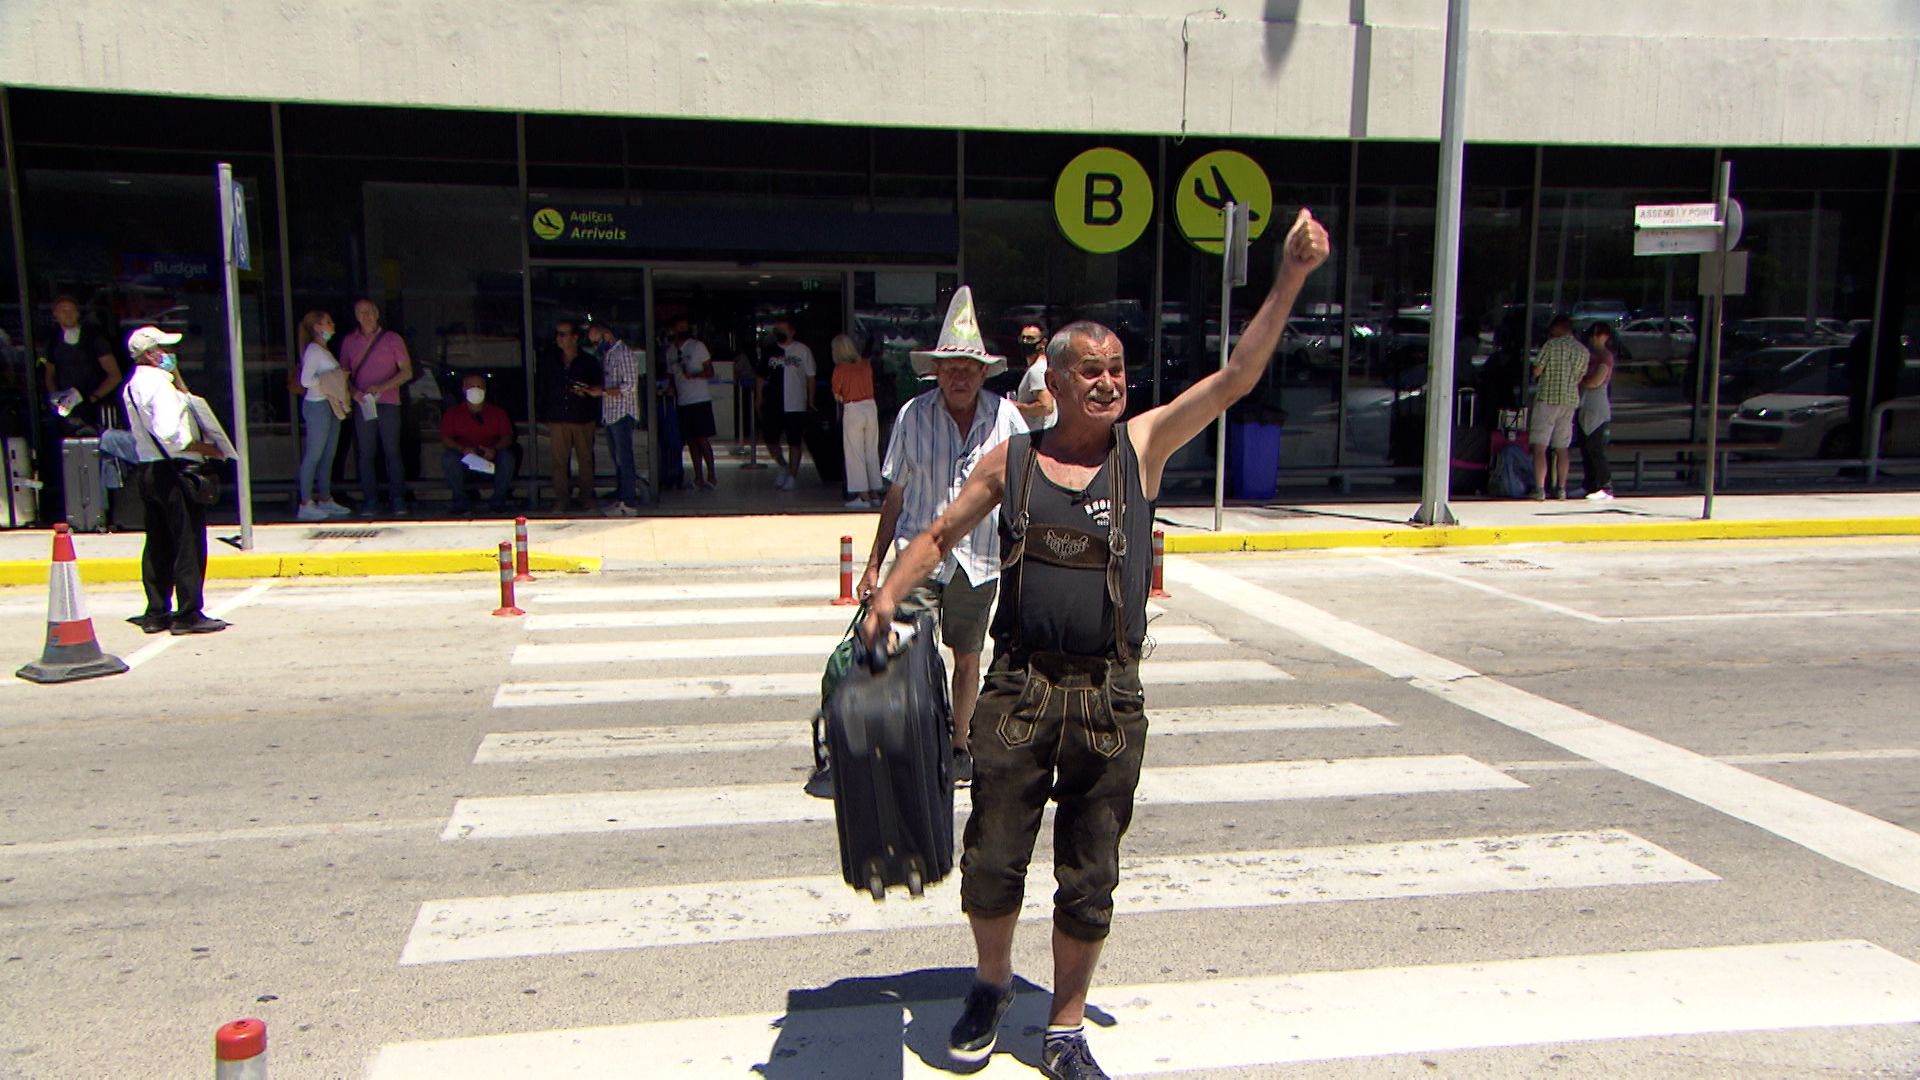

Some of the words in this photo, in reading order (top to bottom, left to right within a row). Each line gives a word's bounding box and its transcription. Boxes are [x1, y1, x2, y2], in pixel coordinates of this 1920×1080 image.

[1084, 172, 1123, 226] B
[570, 226, 627, 241] Arrivals
[153, 260, 208, 279] Budget
